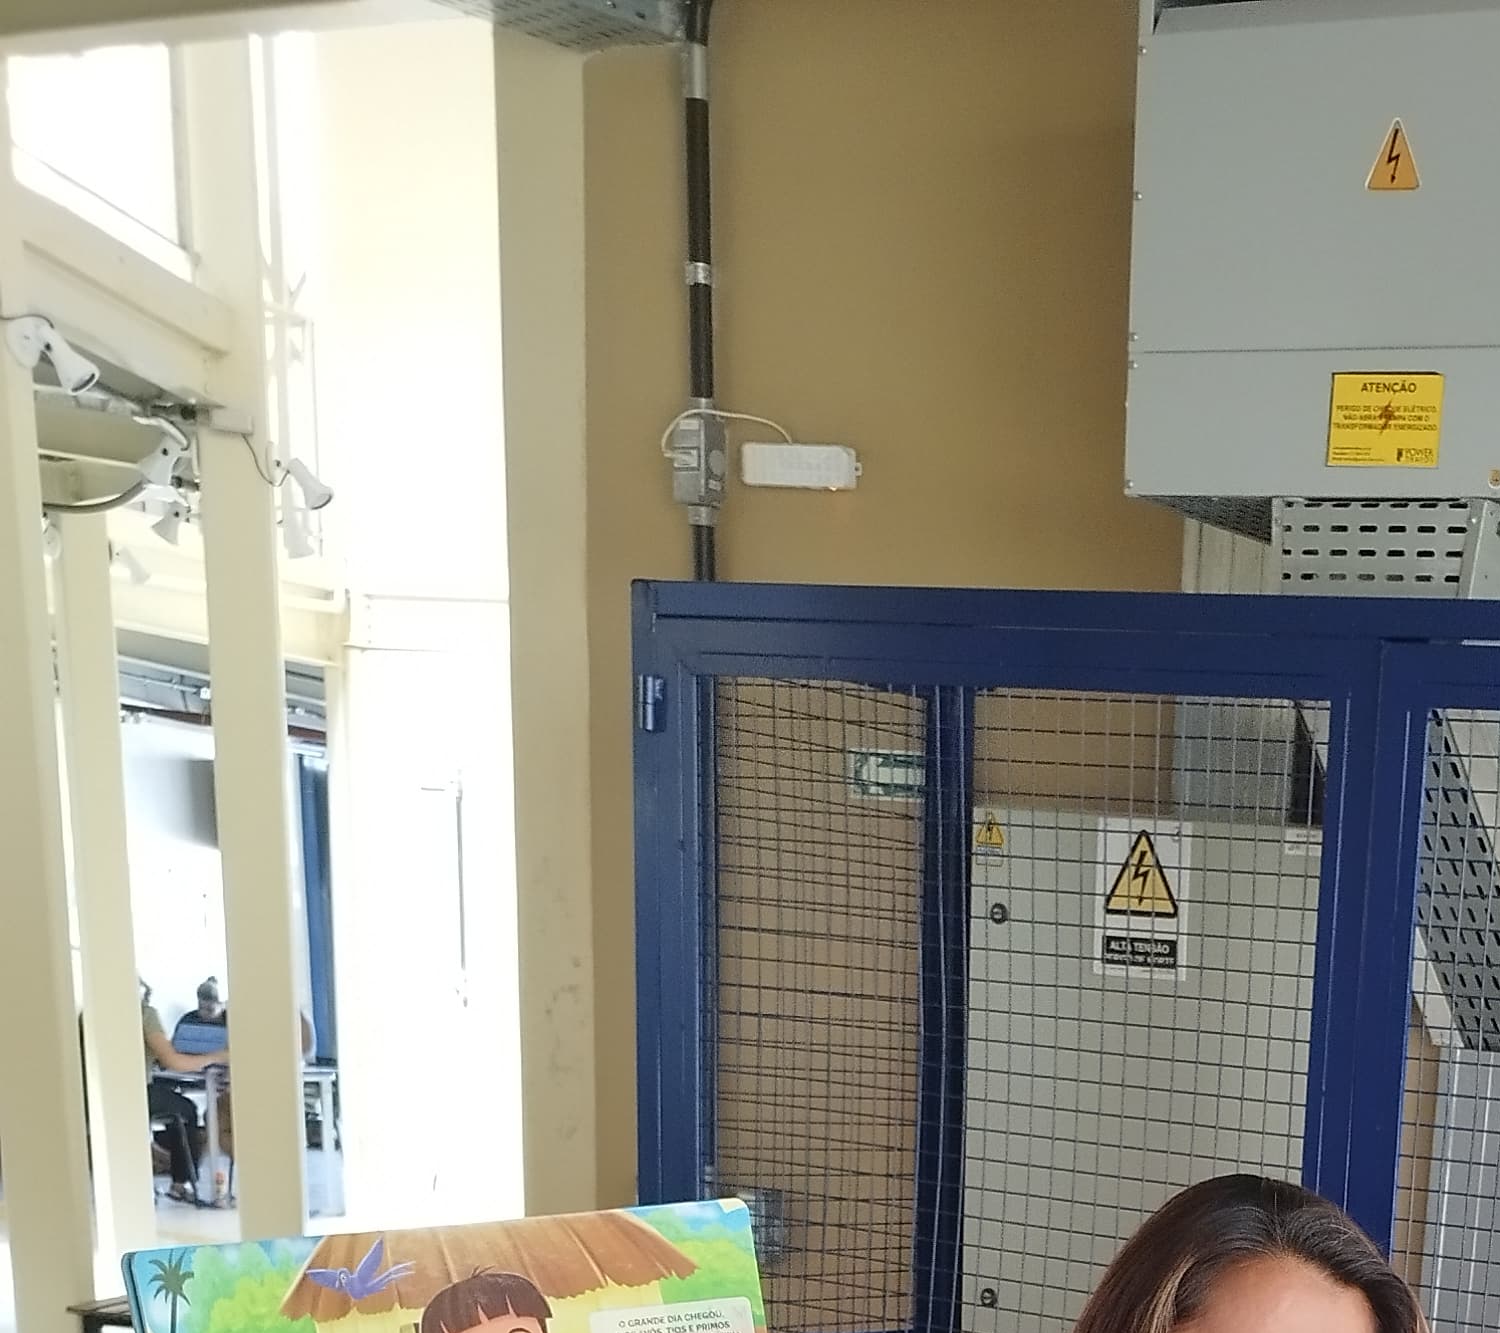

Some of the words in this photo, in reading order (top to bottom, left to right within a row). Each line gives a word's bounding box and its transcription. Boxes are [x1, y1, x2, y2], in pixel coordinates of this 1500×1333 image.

[1361, 380, 1417, 394] ATENÇÃO
[667, 1314, 682, 1323] DIA
[696, 1320, 730, 1331] PRIMOS
